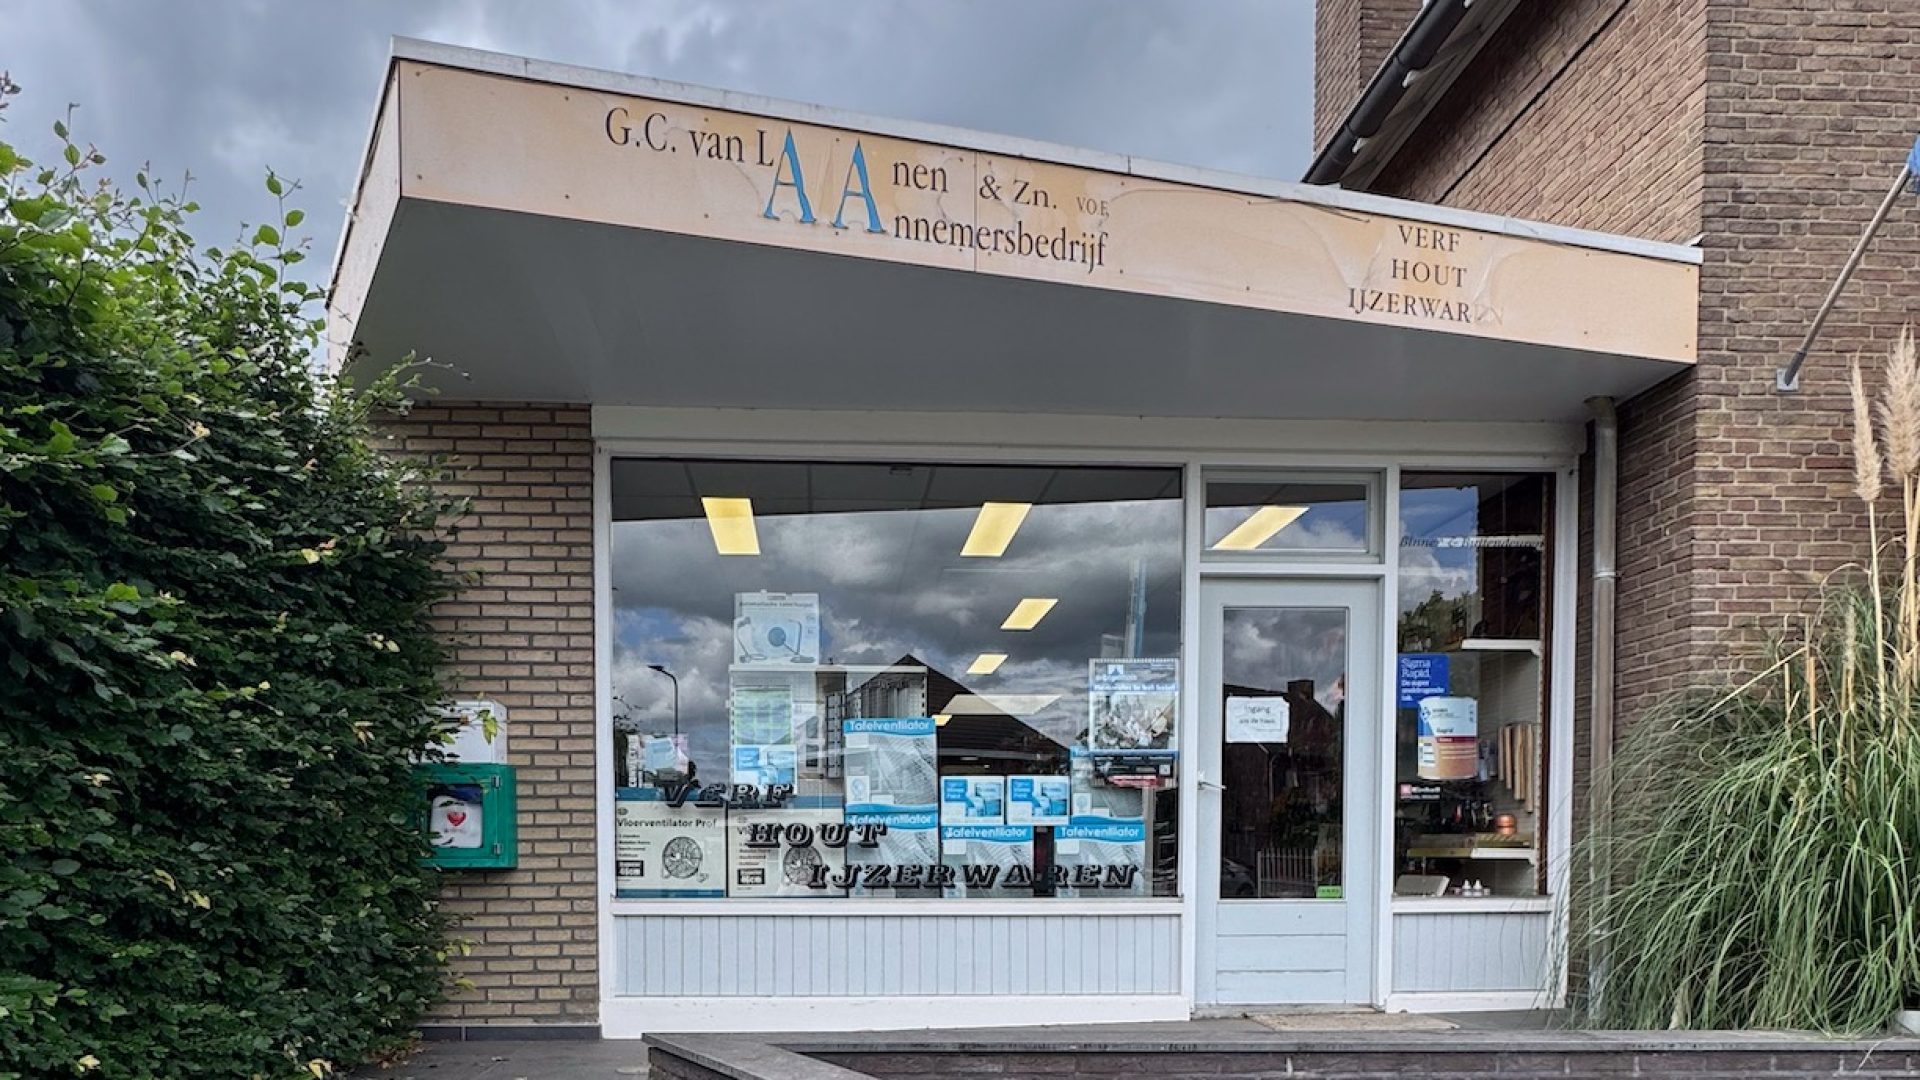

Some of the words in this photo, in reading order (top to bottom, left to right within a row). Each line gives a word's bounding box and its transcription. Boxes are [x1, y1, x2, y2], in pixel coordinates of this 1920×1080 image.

[605, 107, 677, 153] G.C.
[688, 129, 745, 163] van
[979, 175, 1002, 201] &
[1012, 179, 1058, 209] Zn.
[1398, 224, 1461, 252] VERF
[1391, 258, 1468, 289] HOUT
[850, 720, 930, 731] Tafelventilator
[661, 783, 796, 808] VERF
[617, 818, 693, 828] Vloerventilator
[745, 822, 888, 850] HOUT
[1060, 826, 1141, 838] Tafelventilator
[806, 863, 1140, 890] IJZERWAREN
